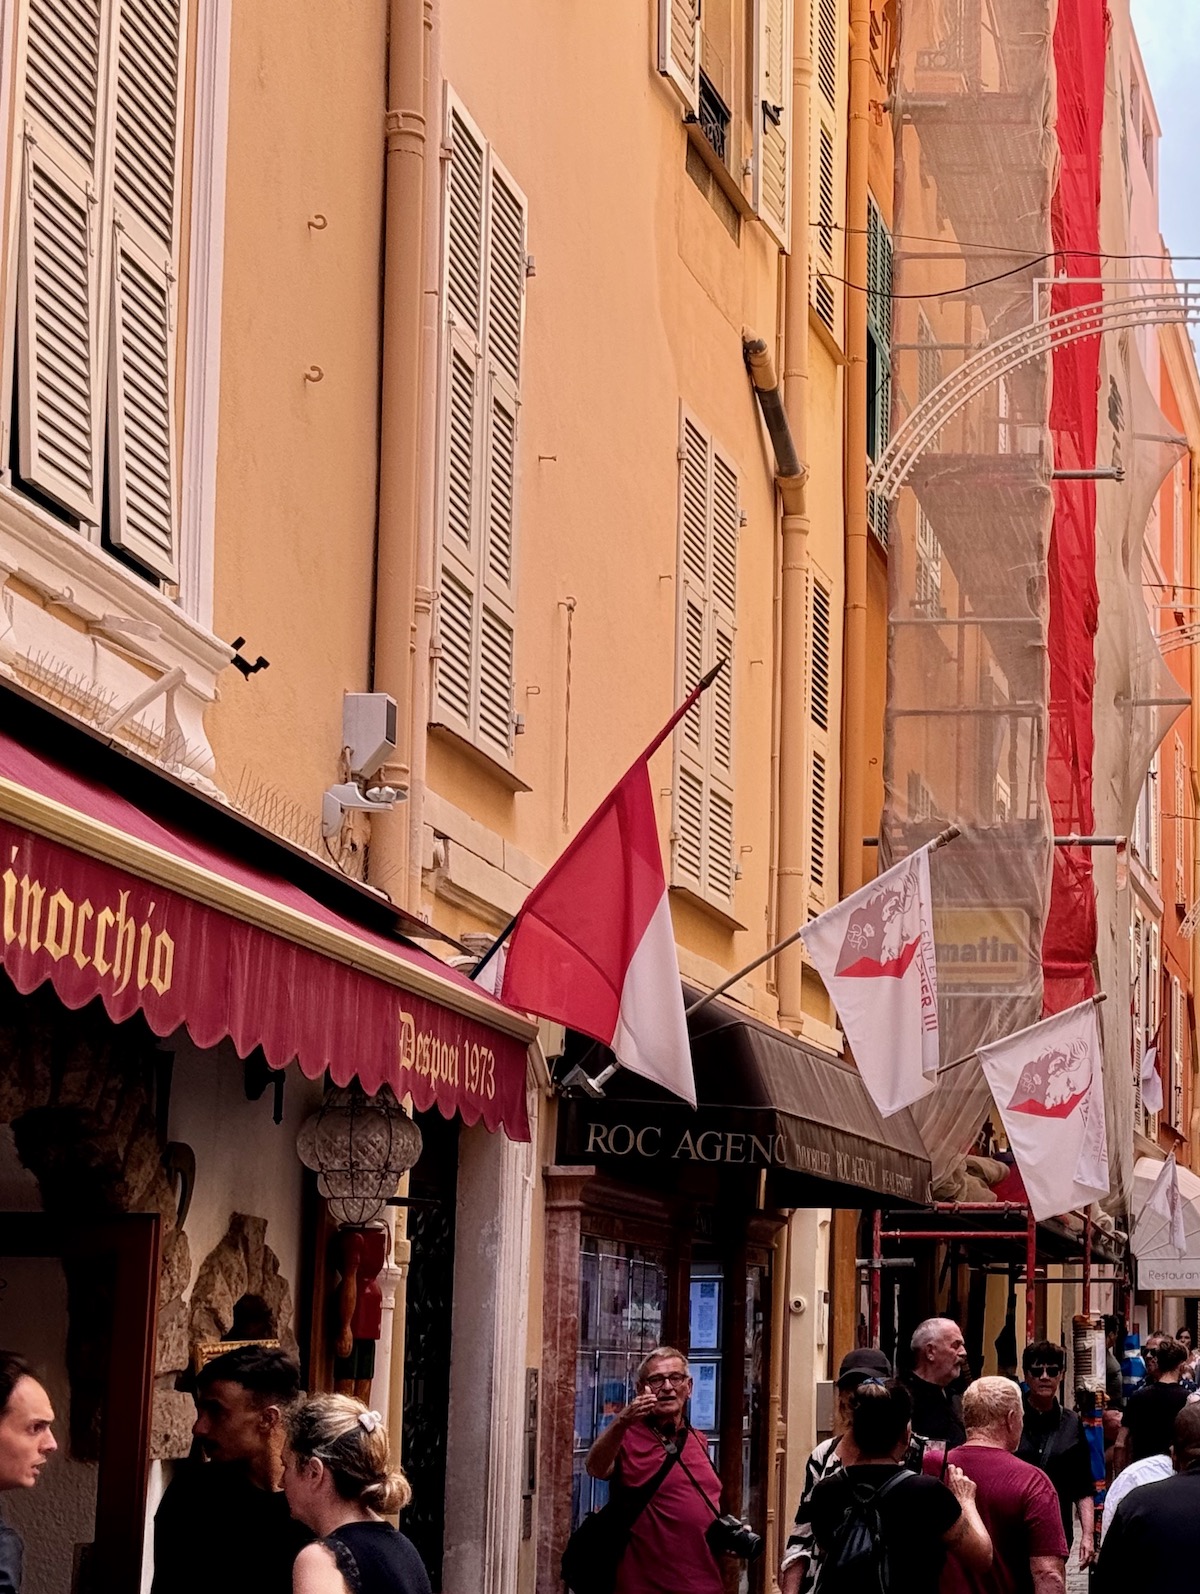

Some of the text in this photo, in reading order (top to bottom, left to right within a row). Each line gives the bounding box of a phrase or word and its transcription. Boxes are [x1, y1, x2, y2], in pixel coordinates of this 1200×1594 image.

[463, 1039, 496, 1101] 1973
[585, 1122, 663, 1158] ROC
[836, 1150, 851, 1181] ROC
[851, 1156, 877, 1188] AGENCY
